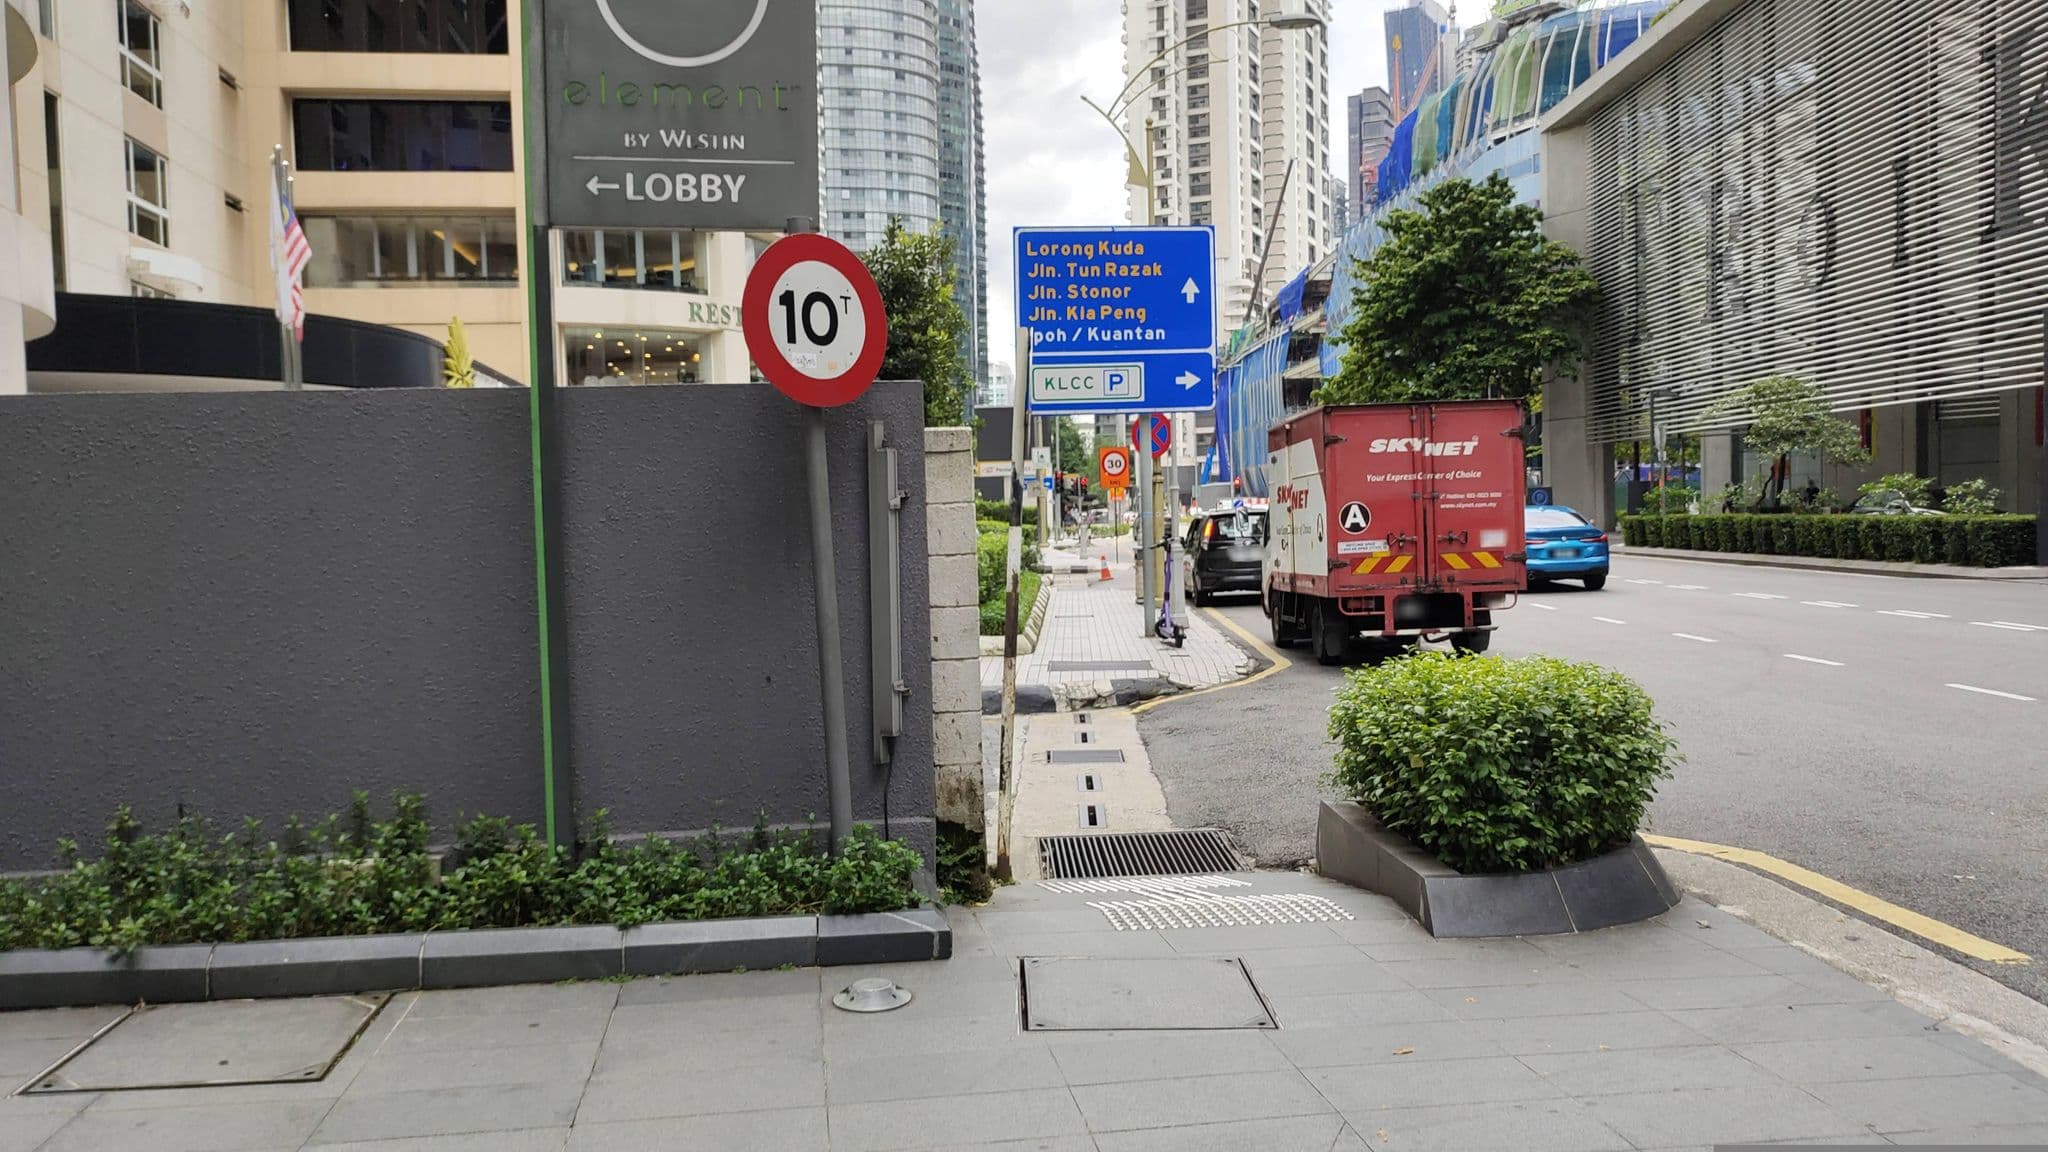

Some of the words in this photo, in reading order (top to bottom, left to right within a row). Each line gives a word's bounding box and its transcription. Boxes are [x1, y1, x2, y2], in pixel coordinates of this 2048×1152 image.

[563, 72, 788, 111] element
[624, 132, 650, 148] BY
[625, 172, 746, 203] LOBBY
[1026, 240, 1094, 260] Lorong
[1098, 240, 1144, 255] Kuda
[1027, 262, 1061, 278] Jln.
[1066, 262, 1100, 277] Tun
[1104, 261, 1162, 277] Razak
[1028, 284, 1062, 300] Jln.
[1067, 284, 1132, 299] Stonor
[1028, 306, 1062, 321] Jln.
[1100, 304, 1146, 324] Peng
[1031, 326, 1067, 346] poh
[1087, 326, 1166, 341] Kuantan
[1045, 376, 1094, 390] KLCC
[1109, 373, 1124, 391] P
[1106, 459, 1122, 469] 30
[1366, 473, 1385, 482] Your
[1445, 471, 1455, 481] of
[1455, 470, 1482, 480] Choice
[1345, 504, 1367, 529] A
